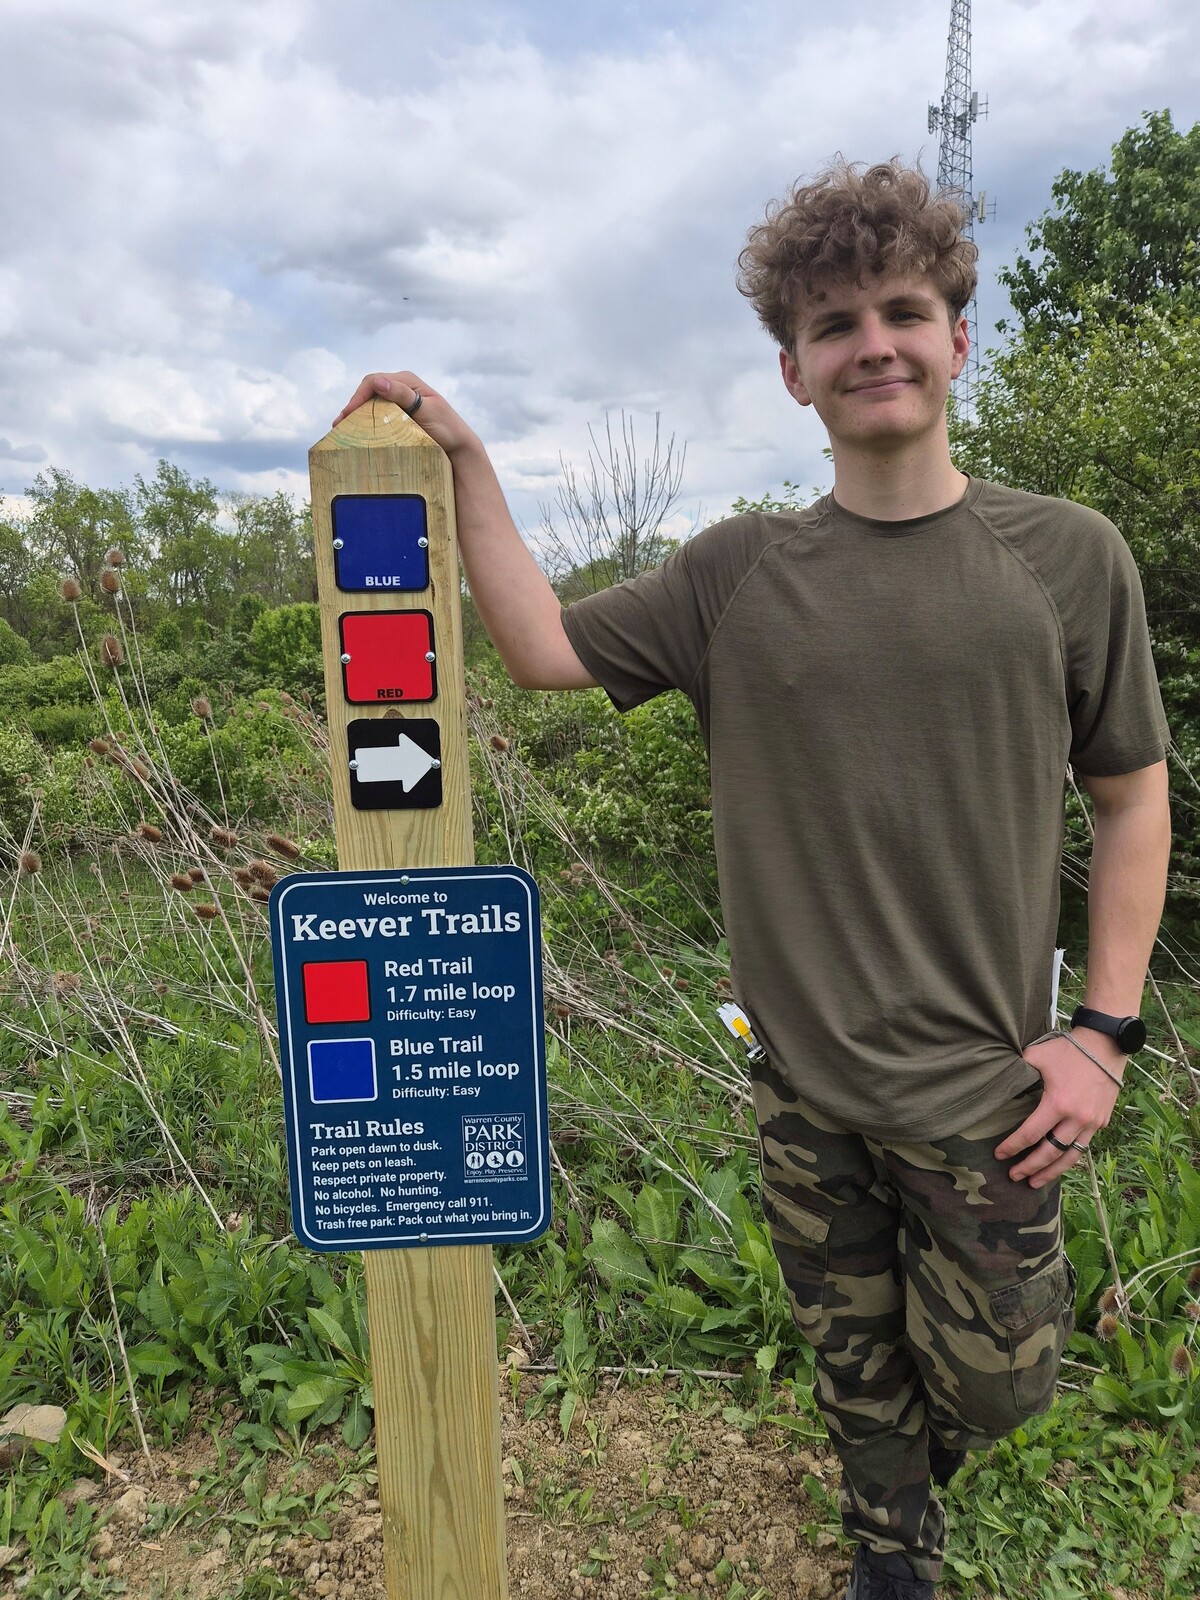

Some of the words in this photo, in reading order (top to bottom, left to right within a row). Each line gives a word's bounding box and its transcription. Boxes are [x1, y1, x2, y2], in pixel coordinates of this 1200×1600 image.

[365, 576, 401, 586] BLUE
[377, 688, 403, 698] RED
[364, 893, 429, 905] Welcome
[433, 892, 447, 903] to
[292, 915, 412, 941] Keever
[421, 905, 521, 935] Trails
[385, 959, 423, 977] Red
[428, 958, 473, 975] Trail
[387, 986, 419, 1002] 1.7
[424, 984, 468, 1001] mile
[472, 982, 515, 1002] loop
[387, 1009, 445, 1022] Difficulty:
[448, 1008, 476, 1020] Easy
[390, 1039, 434, 1056] Blue
[438, 1035, 483, 1053] Trail
[392, 1064, 424, 1081] 1.5
[429, 1063, 472, 1079] mile
[477, 1061, 519, 1081] loop
[392, 1086, 450, 1099] Difficulty:
[453, 1085, 480, 1097] Easy
[310, 1121, 361, 1140] Trail
[366, 1119, 424, 1137] Rules
[465, 1124, 523, 1141] PARK
[311, 1146, 337, 1156] Park
[339, 1146, 366, 1156] open
[369, 1144, 396, 1153] dawn
[399, 1143, 410, 1152] to
[413, 1140, 442, 1151] dusk.
[466, 1140, 523, 1151] DISTRICT
[312, 1161, 339, 1172] Keep
[342, 1160, 365, 1171] pets
[368, 1159, 382, 1168] on
[385, 1157, 416, 1167] leash.
[313, 1175, 357, 1186] Respect
[360, 1173, 397, 1184] private
[400, 1171, 446, 1183] property.
[315, 1191, 329, 1201] No
[333, 1189, 374, 1200] alcohol.
[380, 1188, 395, 1197] No
[398, 1185, 442, 1197] hunting.
[316, 1206, 330, 1215] No
[333, 1203, 380, 1215] bicycles.
[386, 1200, 445, 1212] Emergency
[448, 1198, 467, 1208] call
[469, 1197, 492, 1207] 911.
[316, 1220, 345, 1230] Trash
[348, 1218, 367, 1228] free
[370, 1217, 395, 1229] park:
[399, 1215, 423, 1226] Pack
[426, 1215, 442, 1224] out
[444, 1212, 469, 1223] what
[471, 1213, 489, 1224] you
[492, 1210, 517, 1222] bring
[520, 1210, 532, 1220] in.
